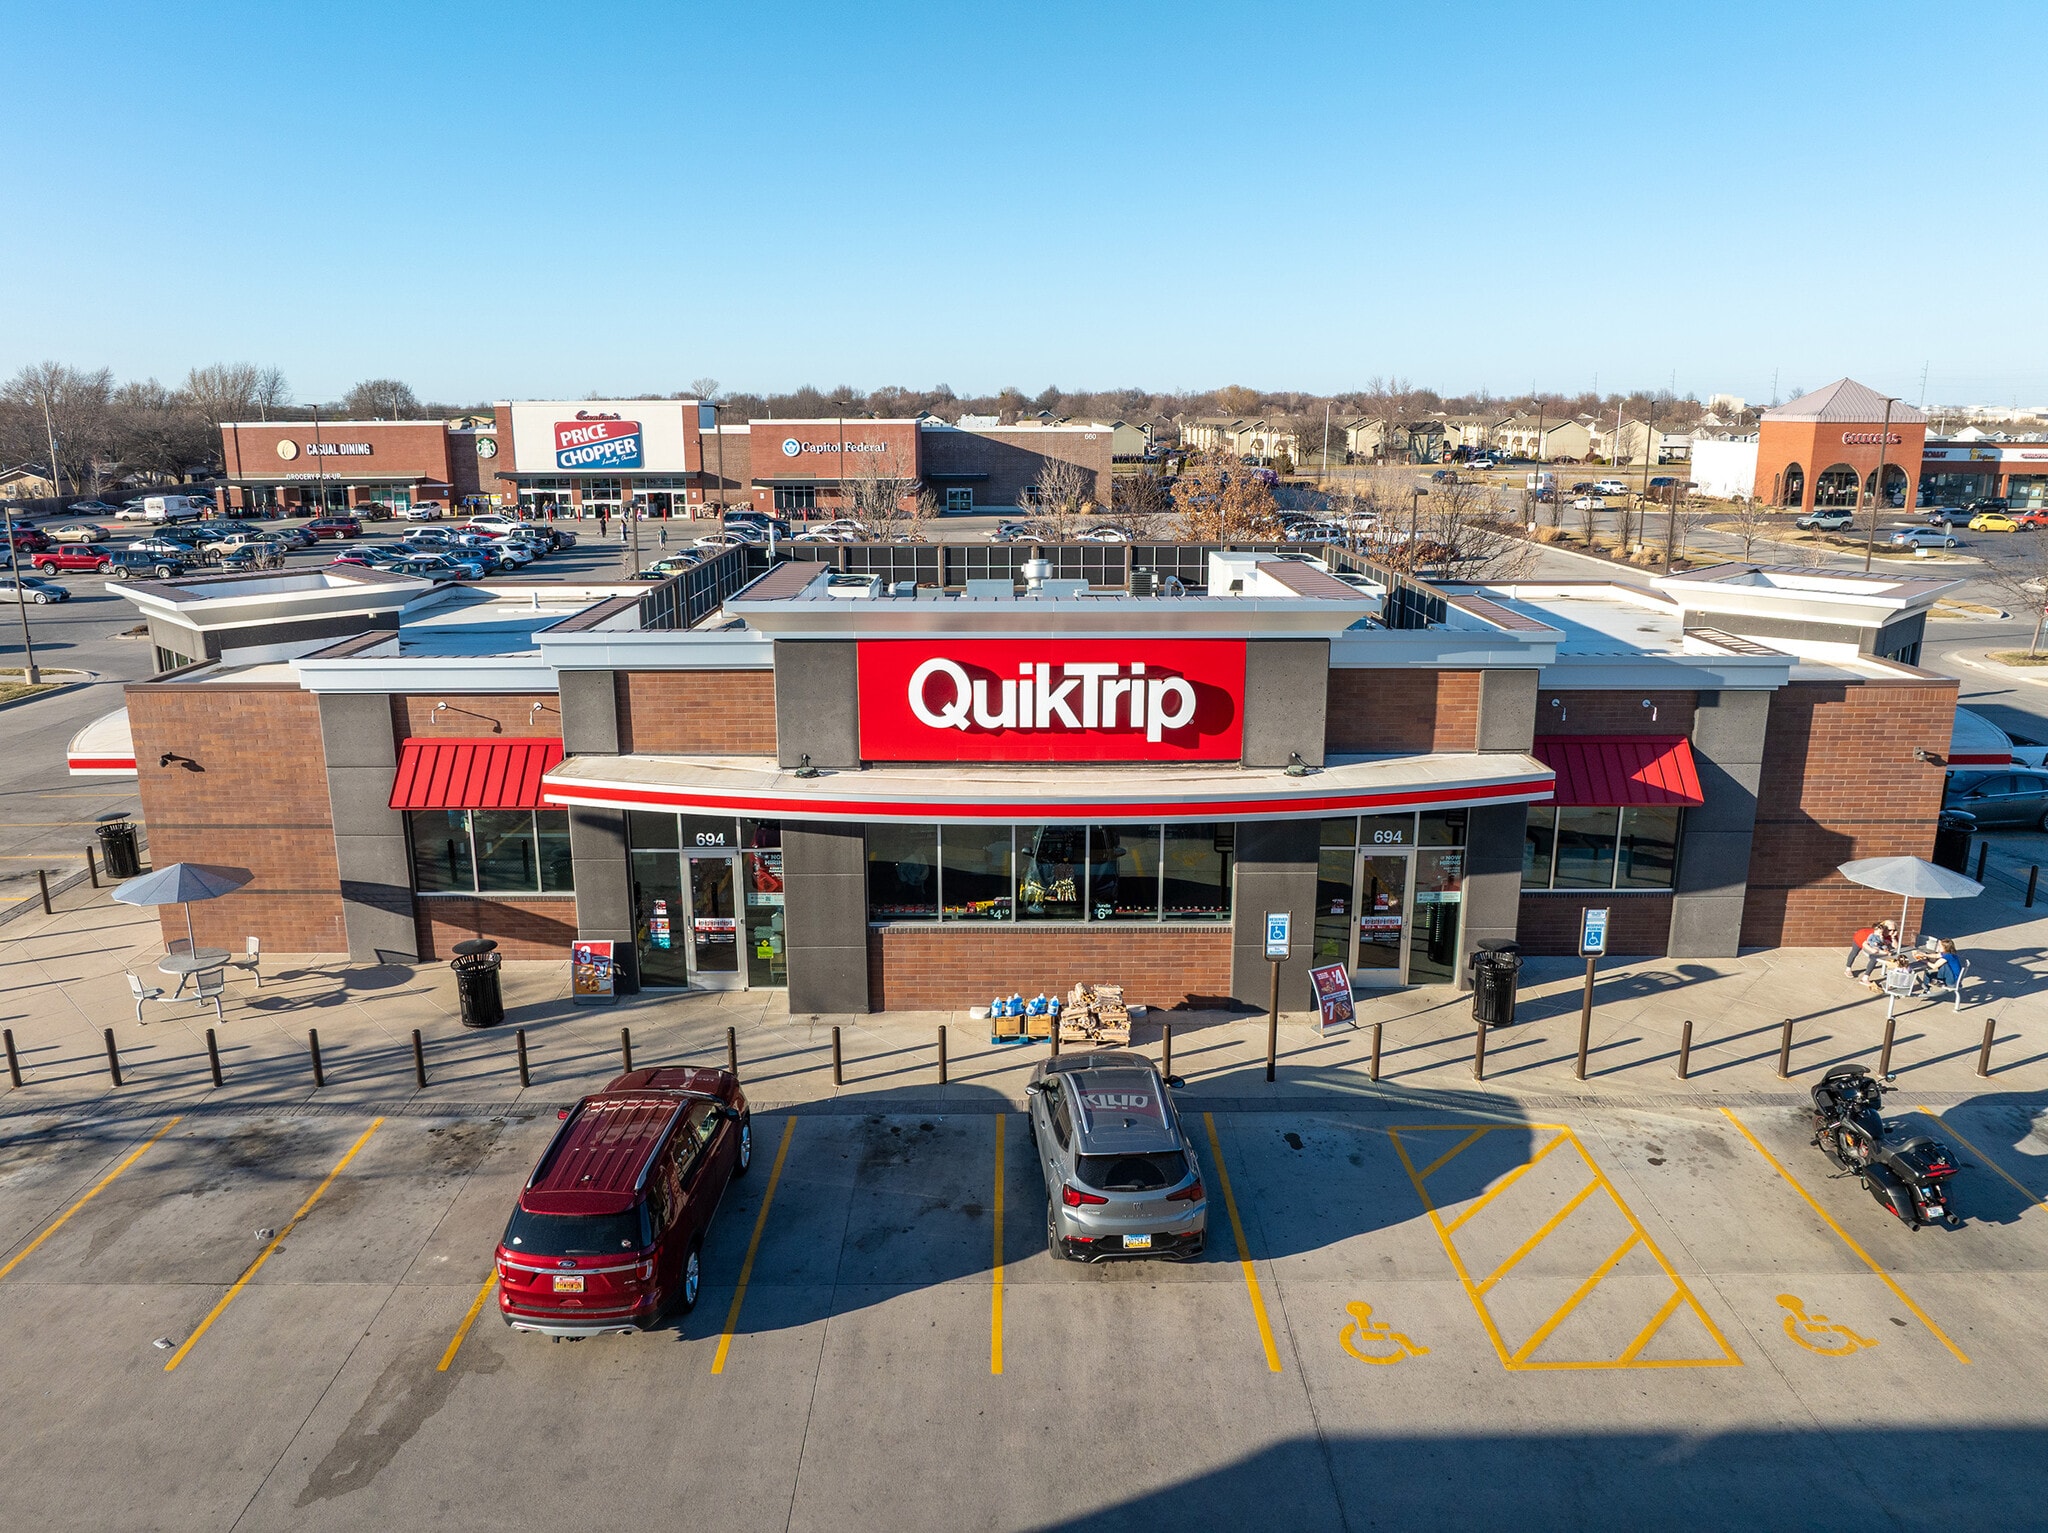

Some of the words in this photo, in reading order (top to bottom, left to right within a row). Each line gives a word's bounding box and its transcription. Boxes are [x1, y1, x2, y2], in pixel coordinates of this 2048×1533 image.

[560, 423, 608, 447] PRICE
[306, 443, 339, 455] CASUAL
[340, 443, 371, 455] DINING
[560, 438, 638, 467] CHOPPER
[801, 441, 841, 454] Capitol
[845, 441, 886, 453] Federal
[315, 472, 341, 480] PCK-UP
[907, 657, 1197, 743] QuikTrip
[696, 832, 726, 847] 694
[1373, 829, 1403, 844] 694
